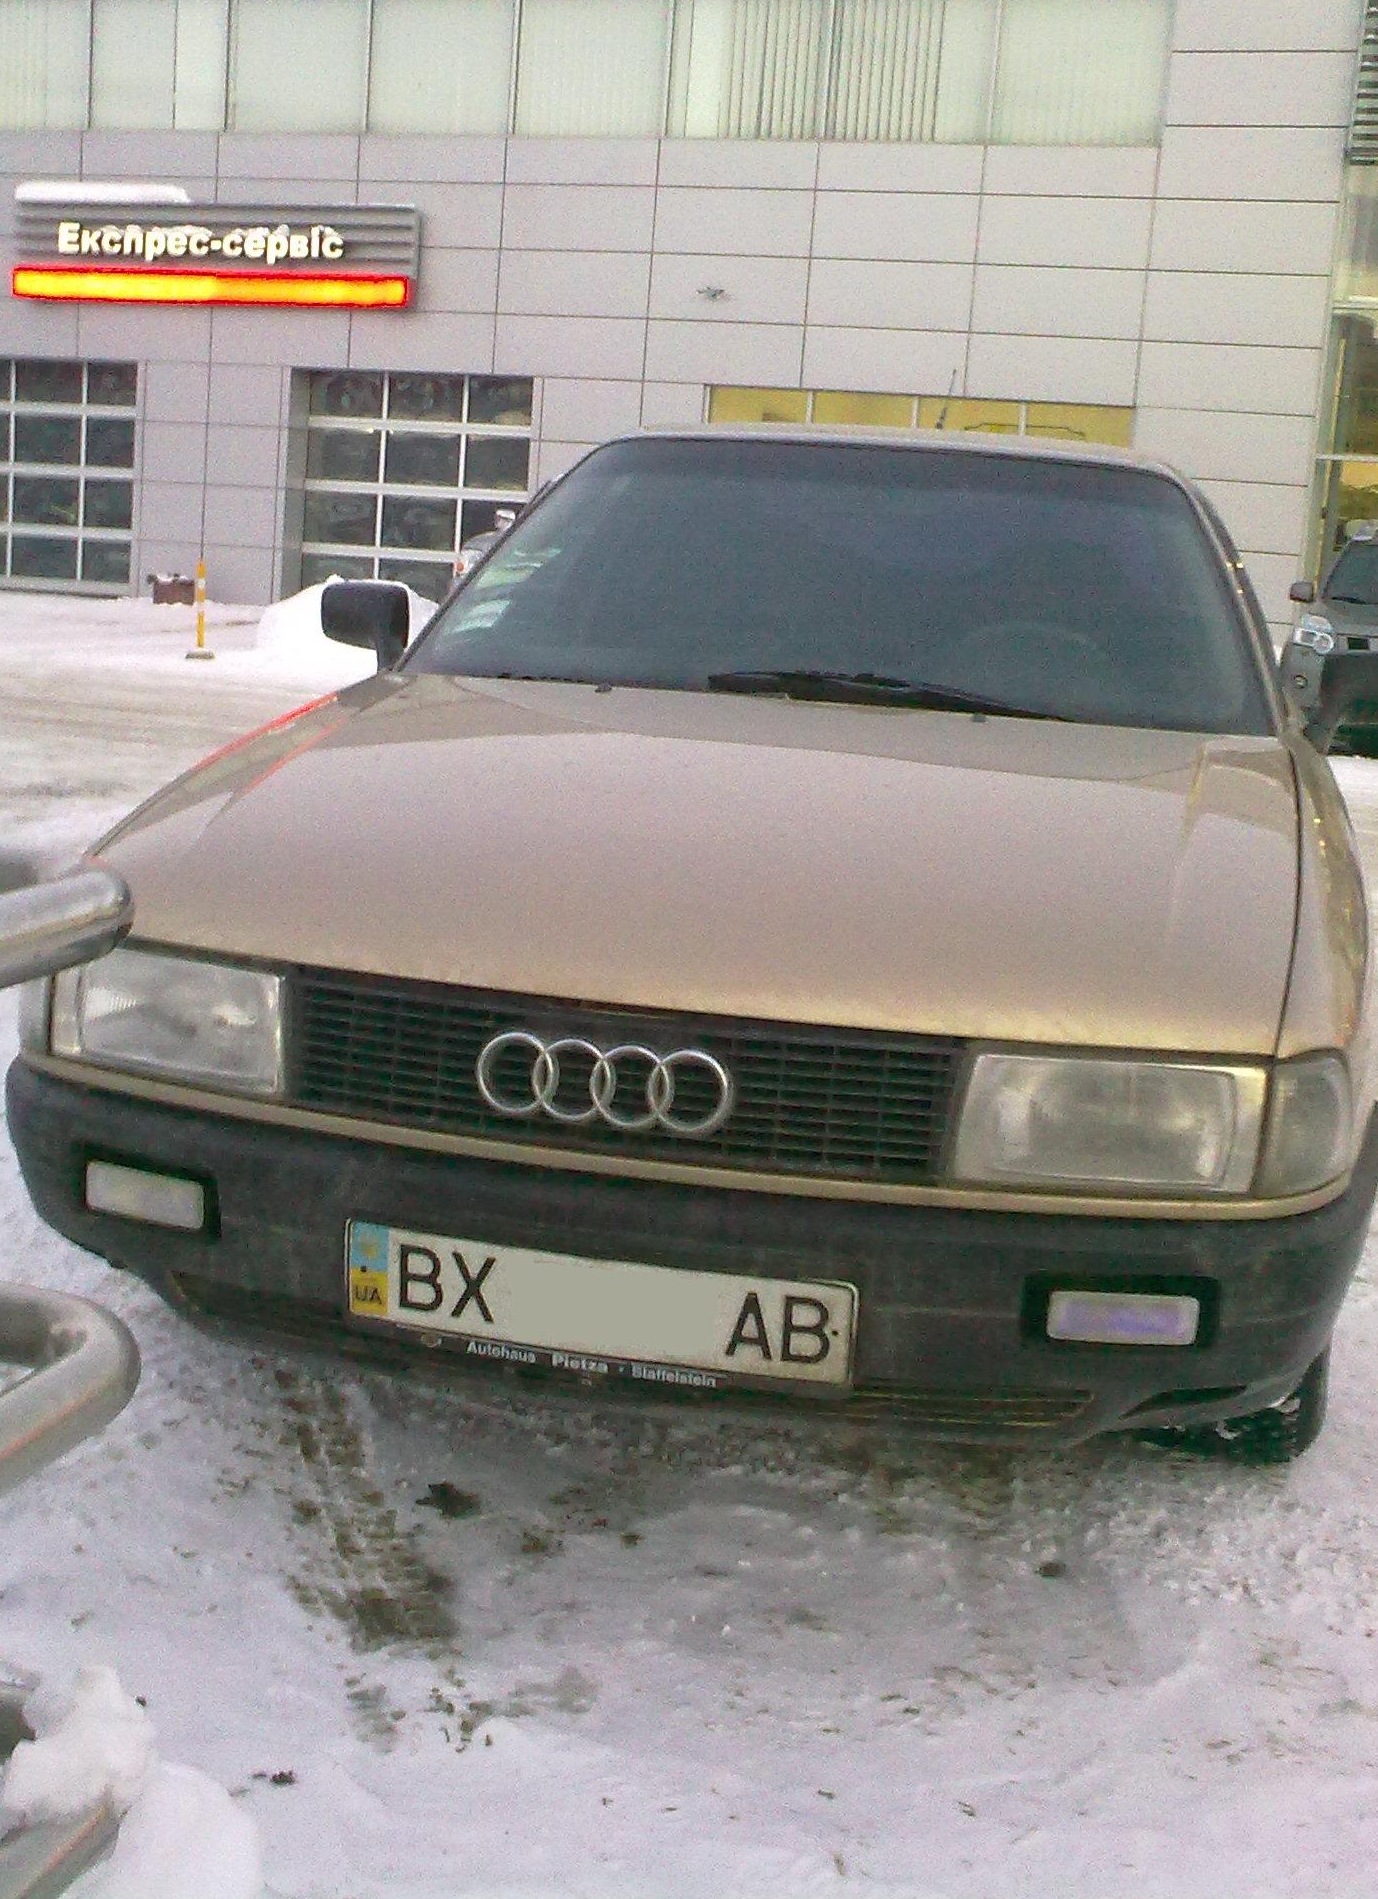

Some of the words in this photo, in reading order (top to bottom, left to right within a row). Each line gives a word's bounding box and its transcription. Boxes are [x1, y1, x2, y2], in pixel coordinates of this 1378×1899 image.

[57, 221, 345, 264] Експрес-сервіс
[355, 1286, 383, 1305] UA
[399, 1244, 496, 1323] BX
[725, 1292, 830, 1364] AB
[466, 1340, 537, 1364] Autohaus
